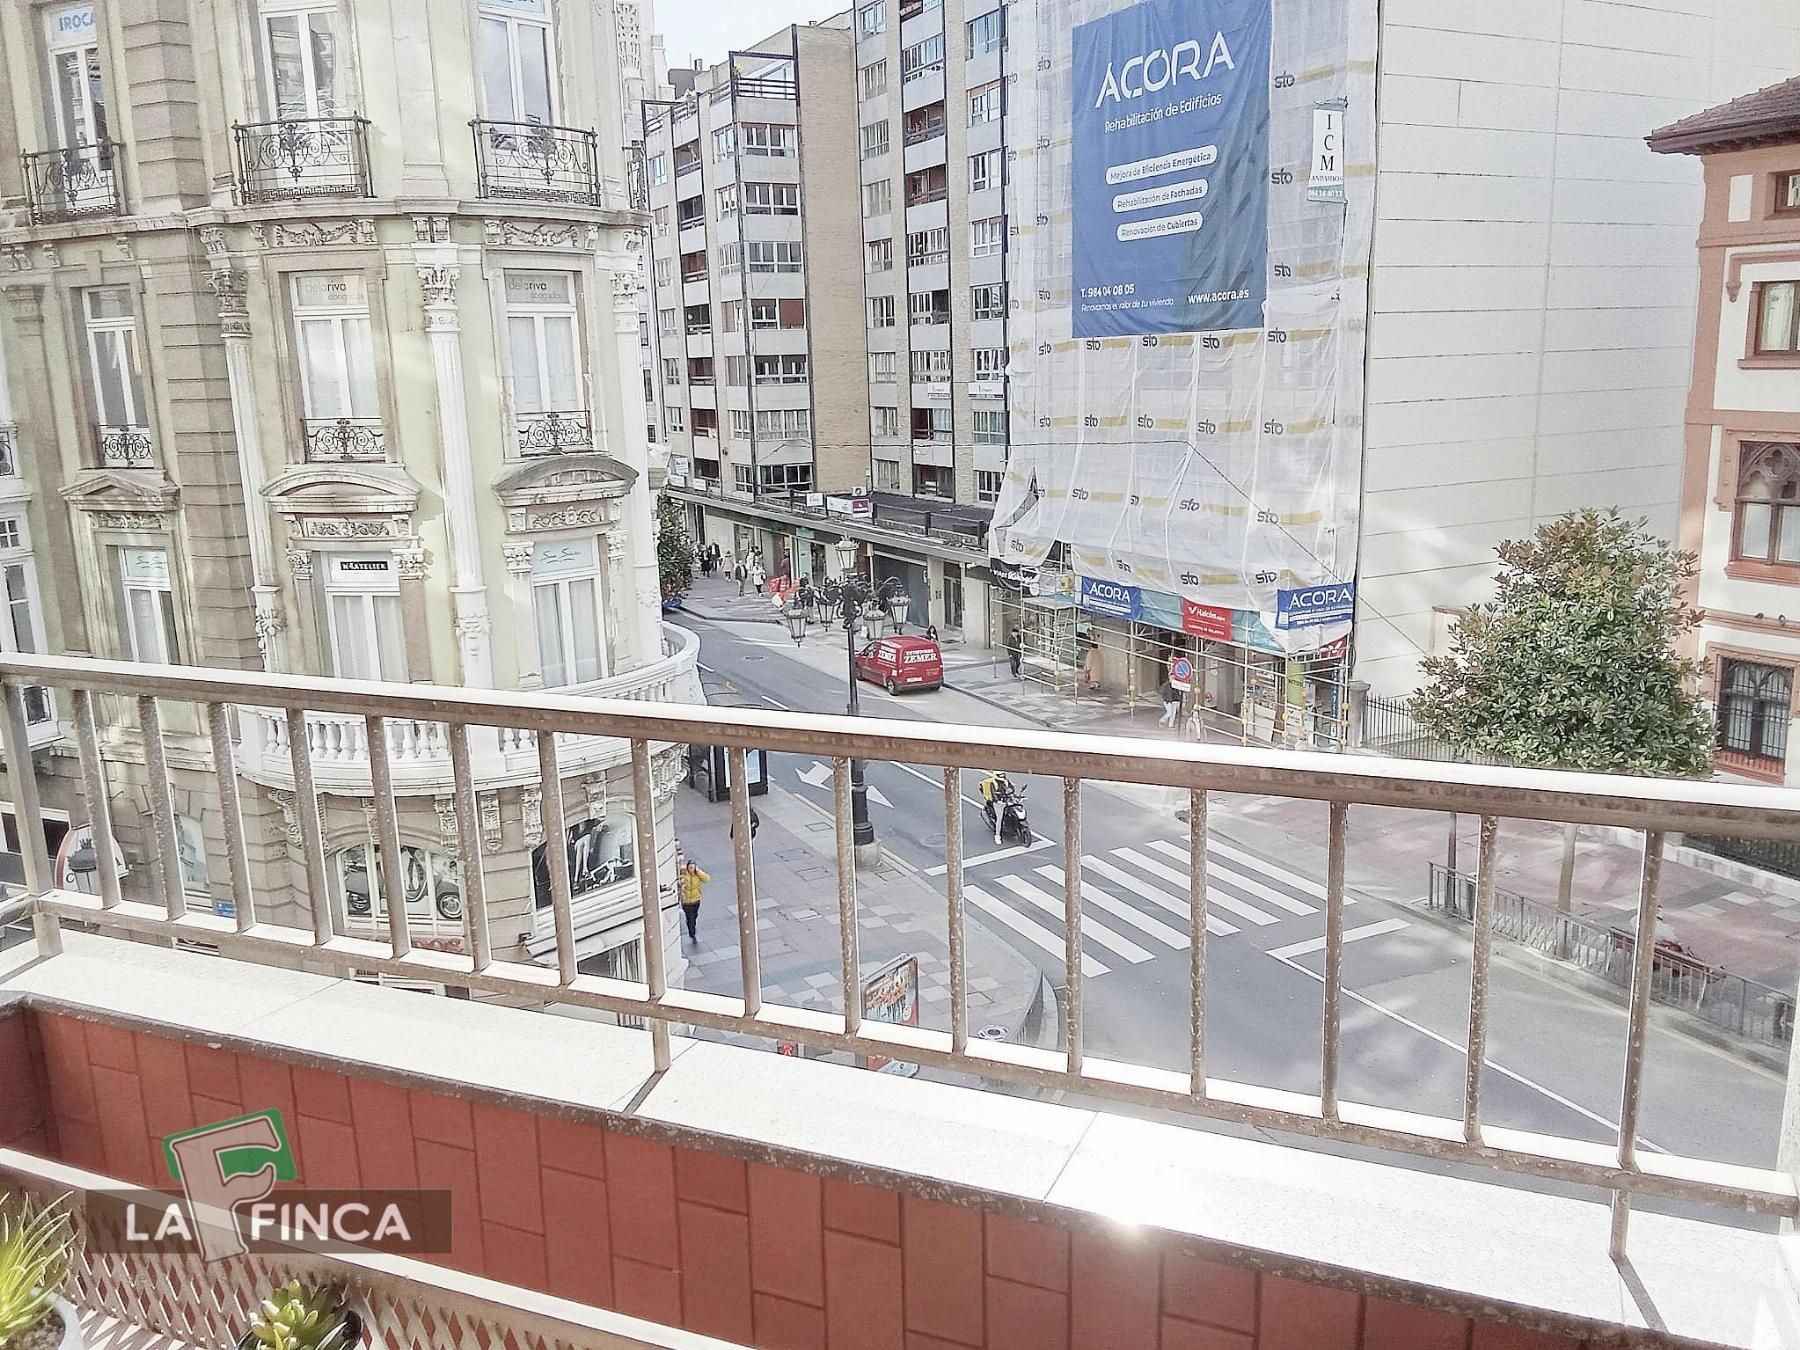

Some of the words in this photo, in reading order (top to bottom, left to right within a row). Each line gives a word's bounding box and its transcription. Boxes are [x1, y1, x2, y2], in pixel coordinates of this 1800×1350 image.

[1094, 30, 1235, 108] ACORA
[1274, 70, 1295, 88] sto
[1104, 106, 1164, 133] Rehabilitación
[1166, 101, 1178, 117] de
[1179, 92, 1223, 113] Edificios
[1110, 170, 1132, 181] Mejora
[1133, 167, 1141, 176] de
[1142, 160, 1171, 174] Eficiencia
[1172, 152, 1211, 167] Energética
[1271, 168, 1292, 184] sto
[1161, 191, 1170, 200] de
[1170, 185, 1203, 199] Fachadas
[1157, 222, 1166, 231] de
[1167, 217, 1198, 230] Cubiertas
[1274, 262, 1292, 277] sto
[1112, 285, 1123, 296] 08
[1124, 283, 1135, 295] 05
[1187, 289, 1250, 305] www.acora.es
[1132, 300, 1141, 308] de
[1142, 334, 1158, 347] sto
[1203, 334, 1220, 350] sto
[1268, 327, 1287, 343] sto
[1039, 340, 1052, 356] sto
[1086, 337, 1101, 351] sto
[1039, 414, 1051, 428] sto
[1084, 414, 1098, 427] sto
[1137, 414, 1154, 428] sto
[1198, 419, 1216, 434] sto
[1264, 419, 1284, 435] sto
[1072, 487, 1089, 500] sto
[1179, 498, 1200, 512] sto
[1257, 508, 1279, 525] sto
[1010, 538, 1024, 552] sto
[1180, 571, 1199, 585] sto
[1255, 570, 1277, 584] sto
[1089, 582, 1131, 603] ACORA
[1289, 588, 1354, 609] ACORA
[903, 652, 938, 664] ZEMER
